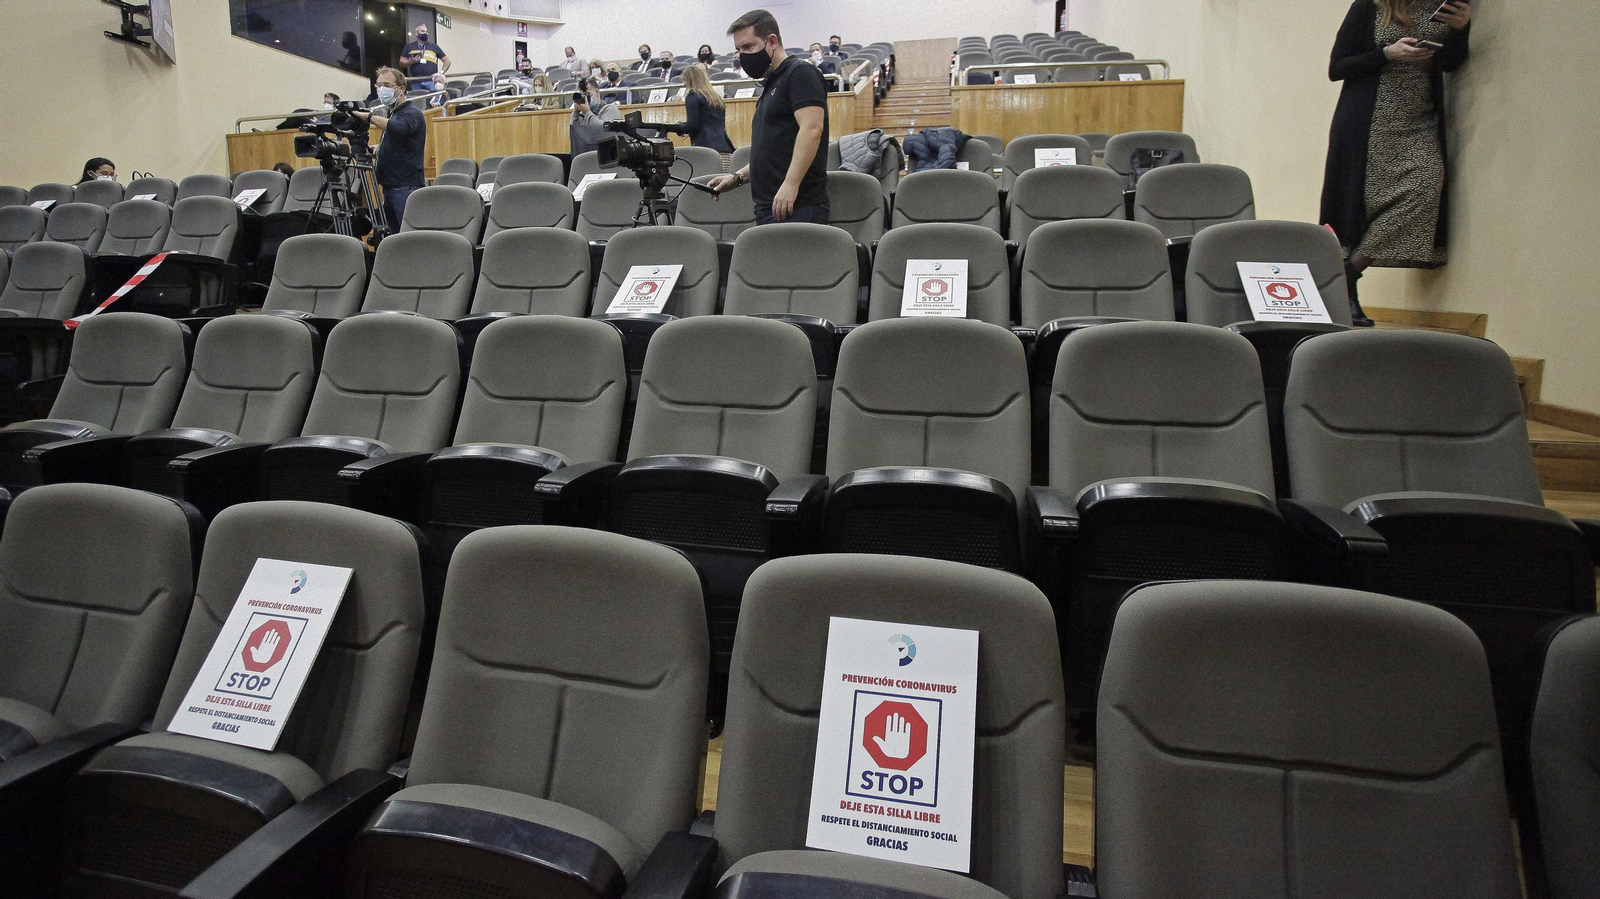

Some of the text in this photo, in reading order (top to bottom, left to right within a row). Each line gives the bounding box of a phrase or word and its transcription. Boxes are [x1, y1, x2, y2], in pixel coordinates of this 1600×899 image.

[248, 600, 322, 614] PREVENCIÓN CORONAVIRUS
[227, 672, 271, 691] STOP
[842, 674, 957, 694] PREVENCIÓN CORONAVIRUS
[206, 695, 272, 712] DEJE ESTA SILLA LIBRE
[188, 706, 209, 715] RESPETE
[214, 710, 258, 723] DISTANCIAMIENTO
[258, 717, 276, 726] SOCIAL
[212, 722, 240, 733] GRACIAS
[860, 770, 924, 796] STOP
[840, 801, 941, 824] DEJE ESTA SILLA LIBRE
[821, 815, 958, 842] RESPETE EL DISTANCIAMIENTO SOCIAL
[866, 836, 908, 851] GRACIAS
